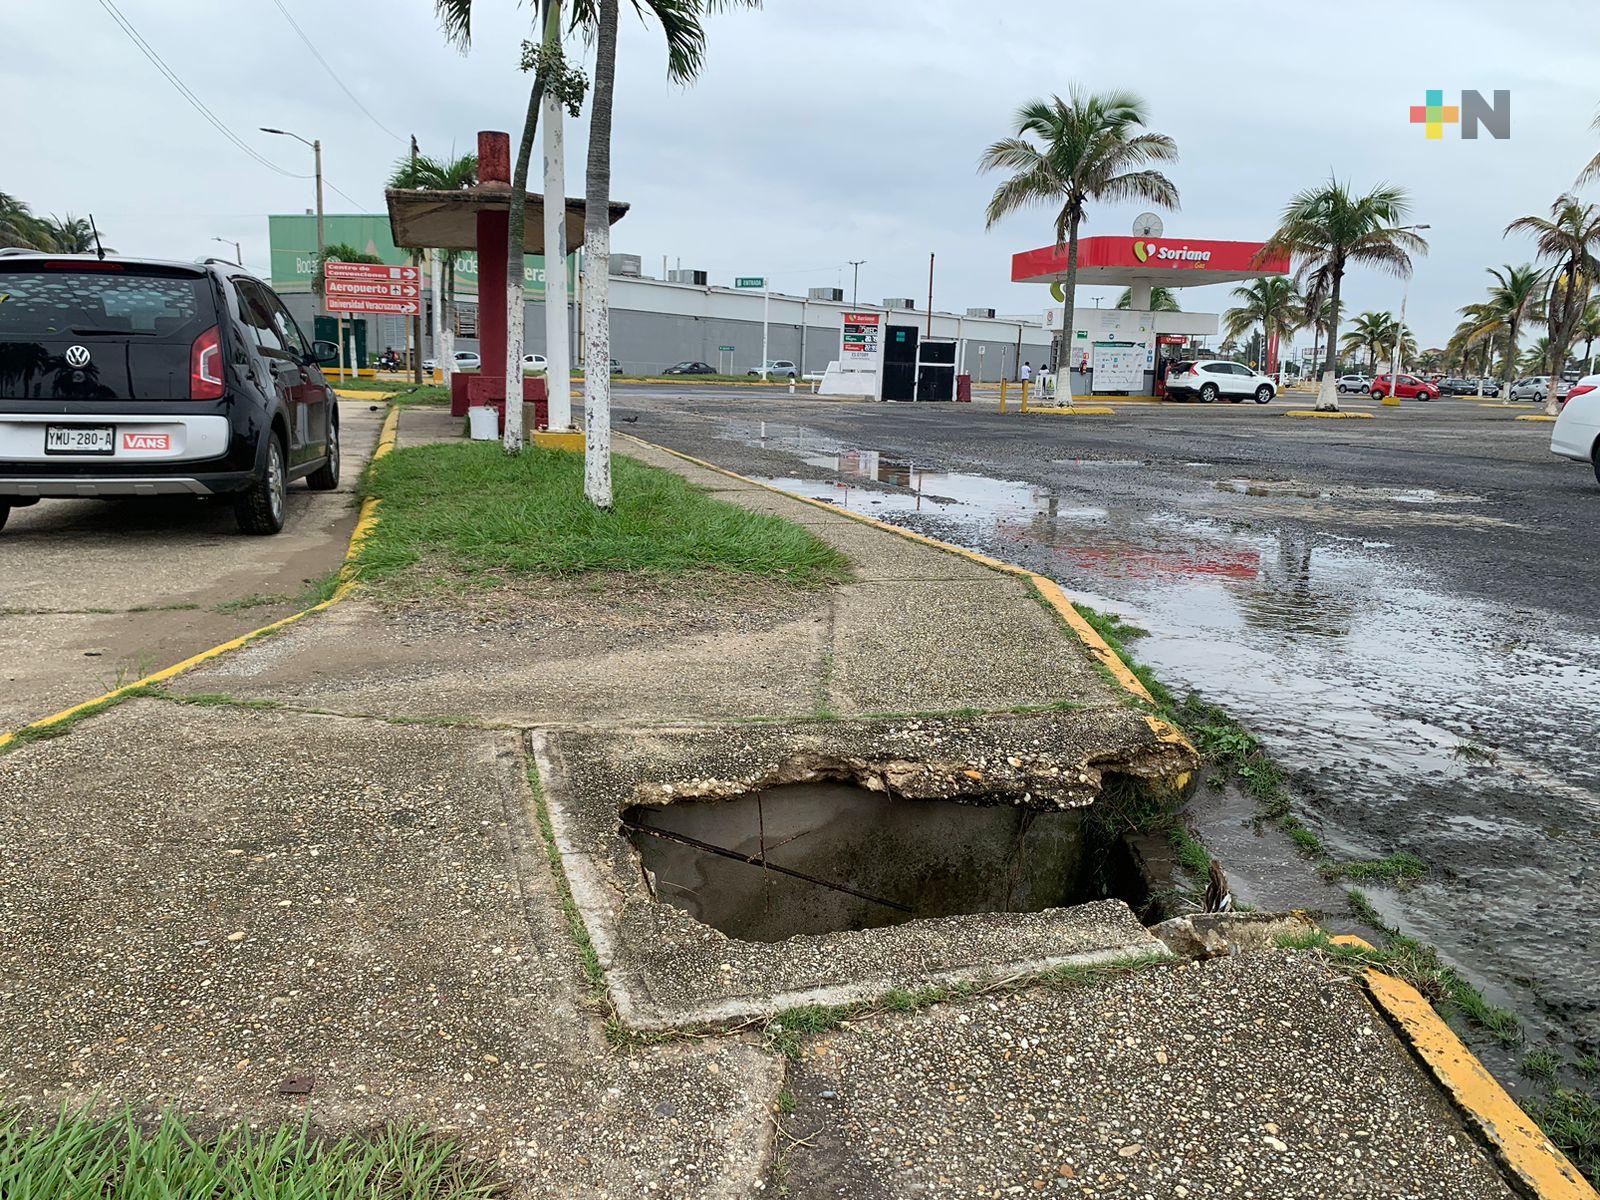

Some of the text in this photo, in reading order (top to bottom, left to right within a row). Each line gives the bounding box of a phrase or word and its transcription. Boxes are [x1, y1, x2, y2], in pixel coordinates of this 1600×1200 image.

[1157, 245, 1211, 261] Soriana
[328, 263, 357, 271] Centro
[1194, 261, 1206, 269] Gas
[328, 270, 388, 278] Convenciones
[329, 282, 388, 294] Aeropuerto
[328, 299, 365, 309] Universidad
[49, 432, 112, 446] YMU-280-A
[125, 435, 168, 449] VANS
